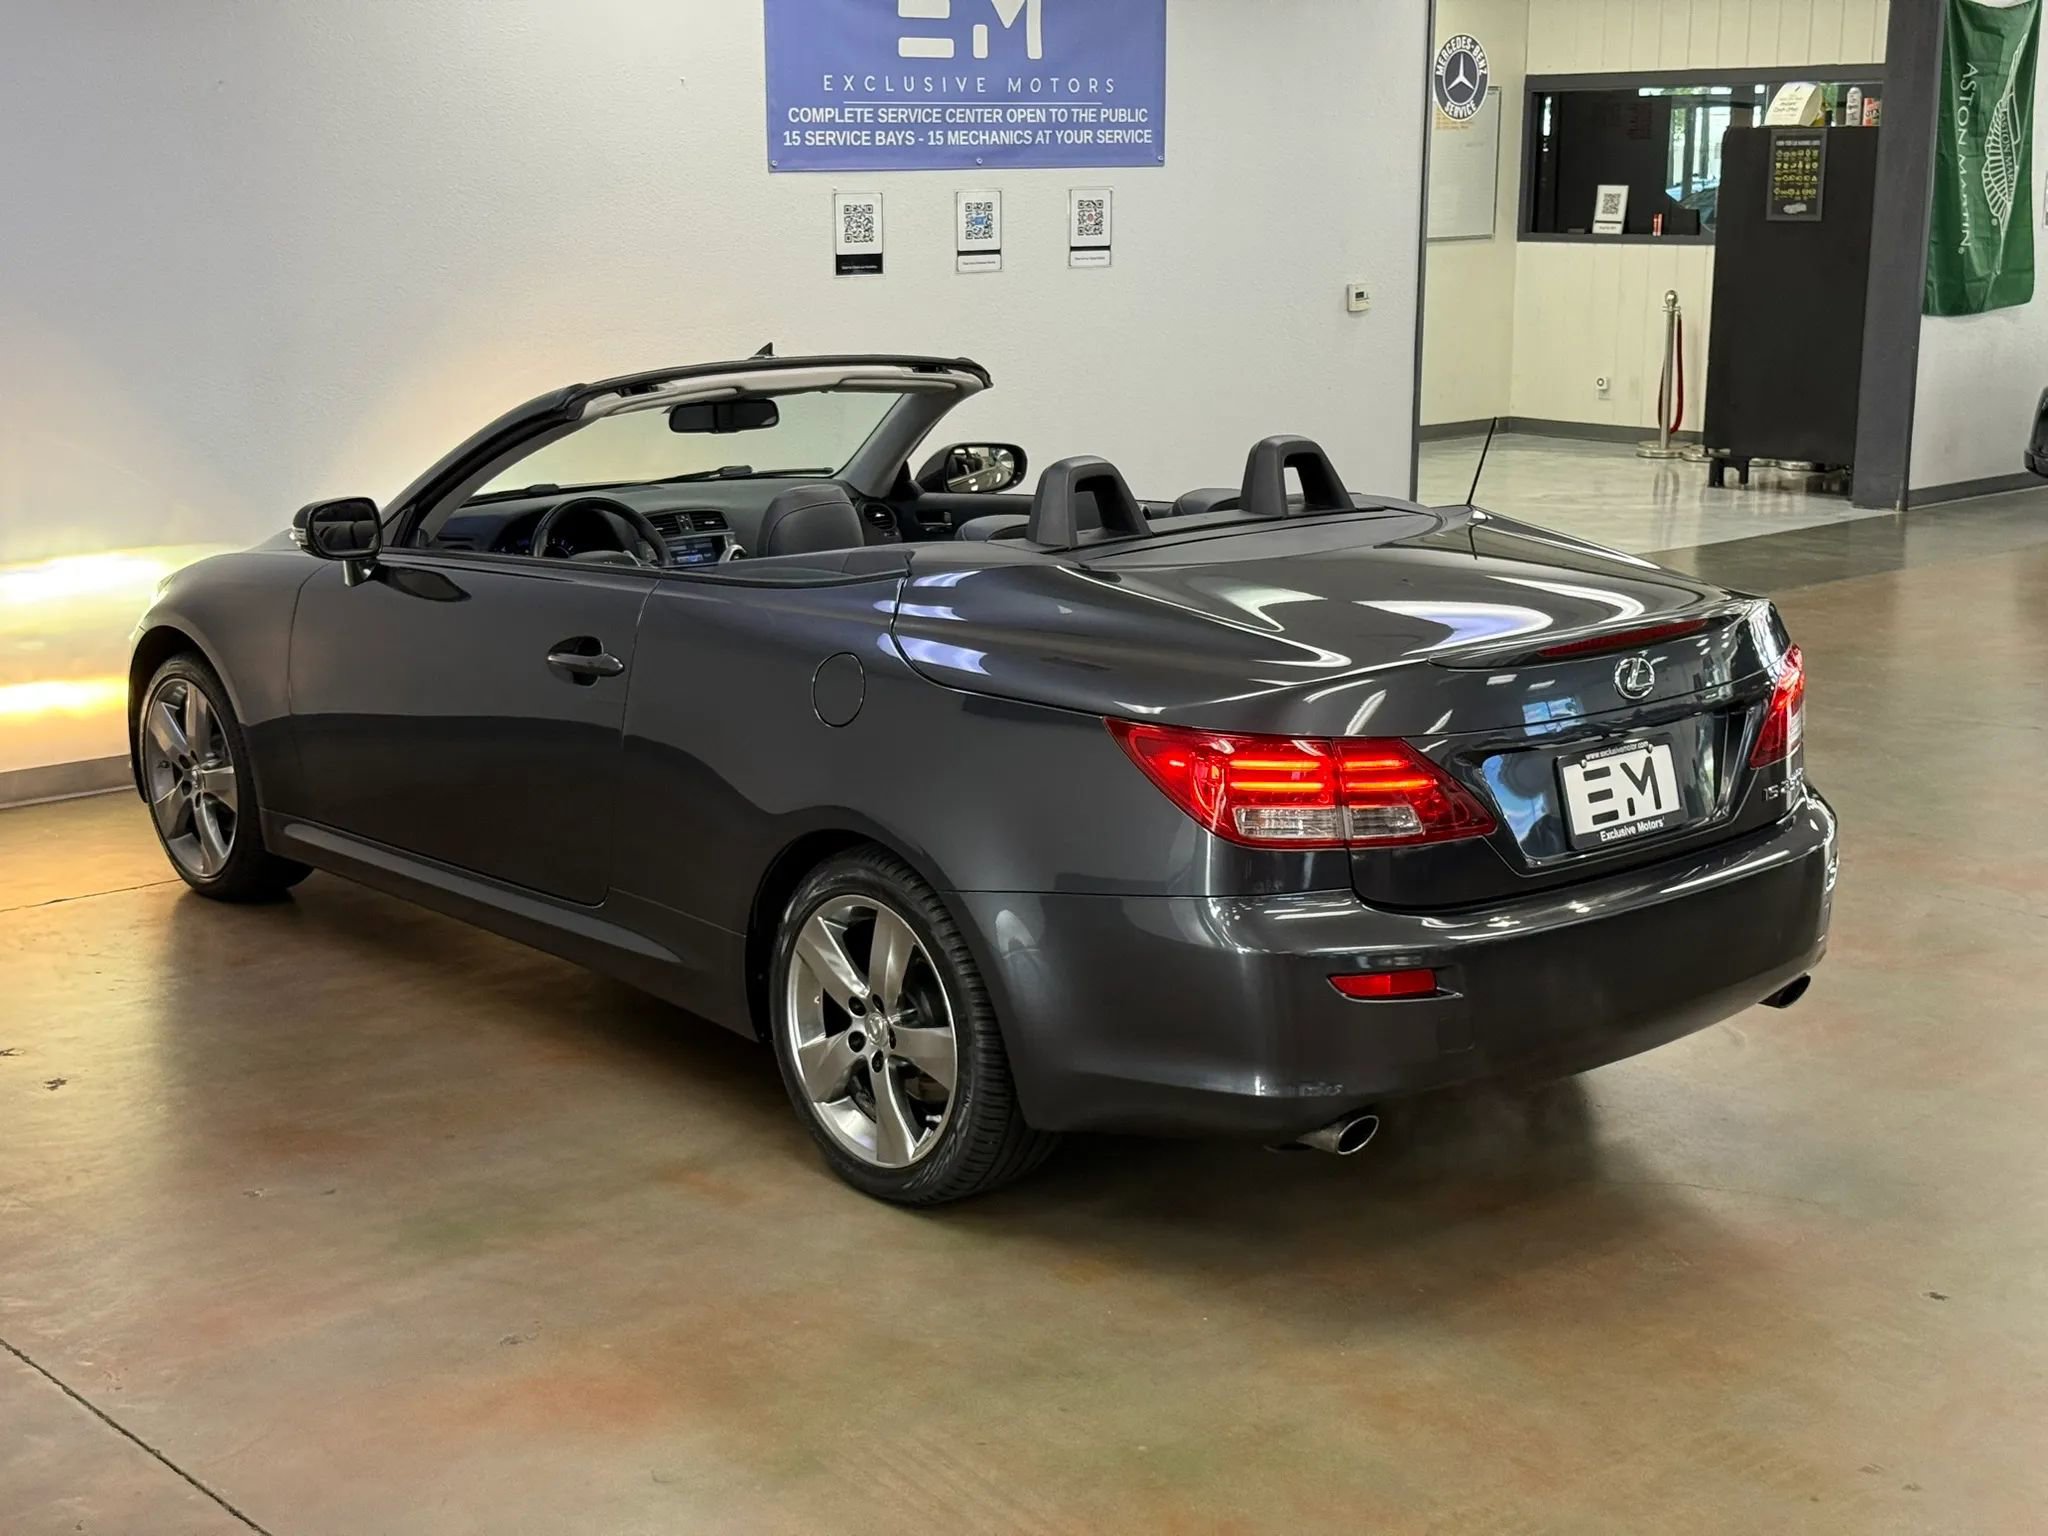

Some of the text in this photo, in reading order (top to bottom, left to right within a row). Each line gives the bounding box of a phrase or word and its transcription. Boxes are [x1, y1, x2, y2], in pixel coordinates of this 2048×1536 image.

[1435, 36, 1488, 76] MERCEDES-BENZ
[823, 74, 1115, 94] EXCLUSIVE MOTORS
[1444, 99, 1477, 118] SERVICE
[1957, 61, 1979, 146] ASTON
[788, 107, 1149, 124] COMPLETE SERVICE CENTER OPEN TO THE PUBLIC
[783, 130, 801, 146] 15
[804, 130, 872, 146] SERVICE
[875, 130, 916, 146] BAYS
[927, 130, 944, 145] 15
[947, 130, 1033, 146] MECHANICS
[1035, 130, 1053, 144] AT
[1055, 129, 1094, 144] YOUR
[1096, 129, 1153, 144] SERVICE
[1600, 818, 1664, 842] Exclusive Motors
